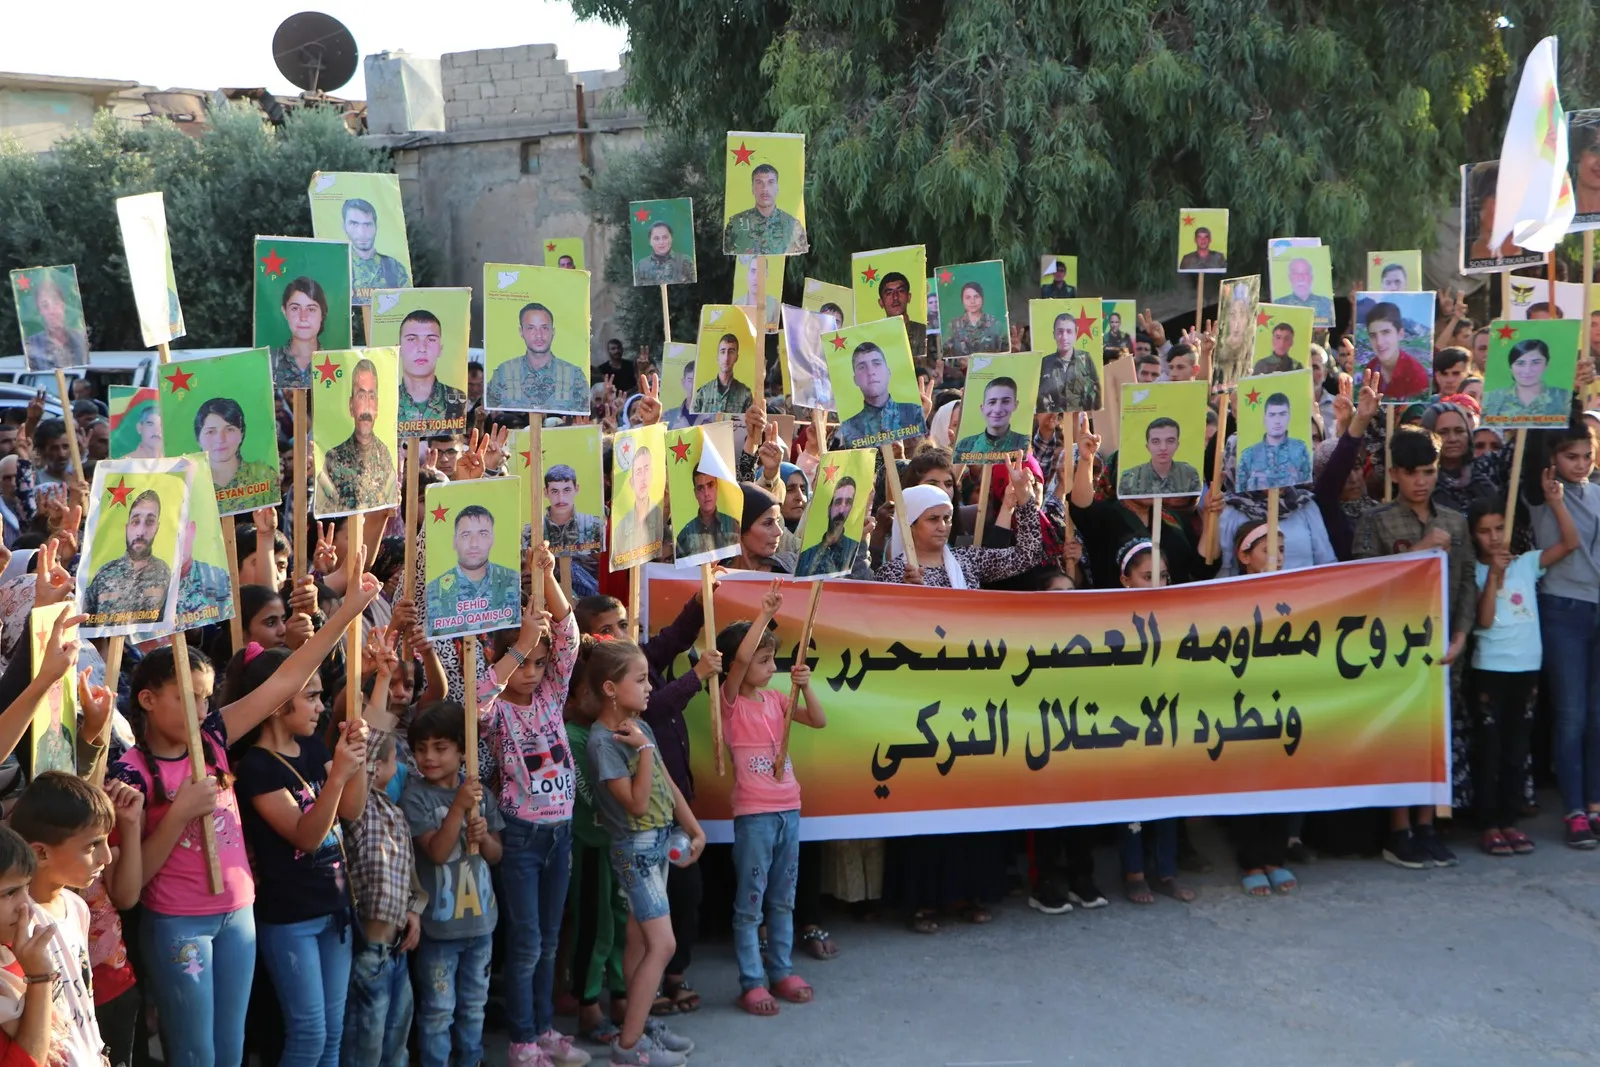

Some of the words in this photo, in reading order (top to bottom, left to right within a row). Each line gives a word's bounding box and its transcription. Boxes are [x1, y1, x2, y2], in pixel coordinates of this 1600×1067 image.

[827, 624, 1008, 692] سنحرر
[1011, 611, 1161, 687] العصر
[1176, 602, 1321, 679] مقاومه
[1336, 615, 1433, 679] بروح
[872, 697, 1009, 800] التركي
[1025, 692, 1180, 771] الاحتلال
[1193, 690, 1302, 762] ونطرد
[531, 774, 572, 795] LOVE
[432, 860, 496, 922] BAB
